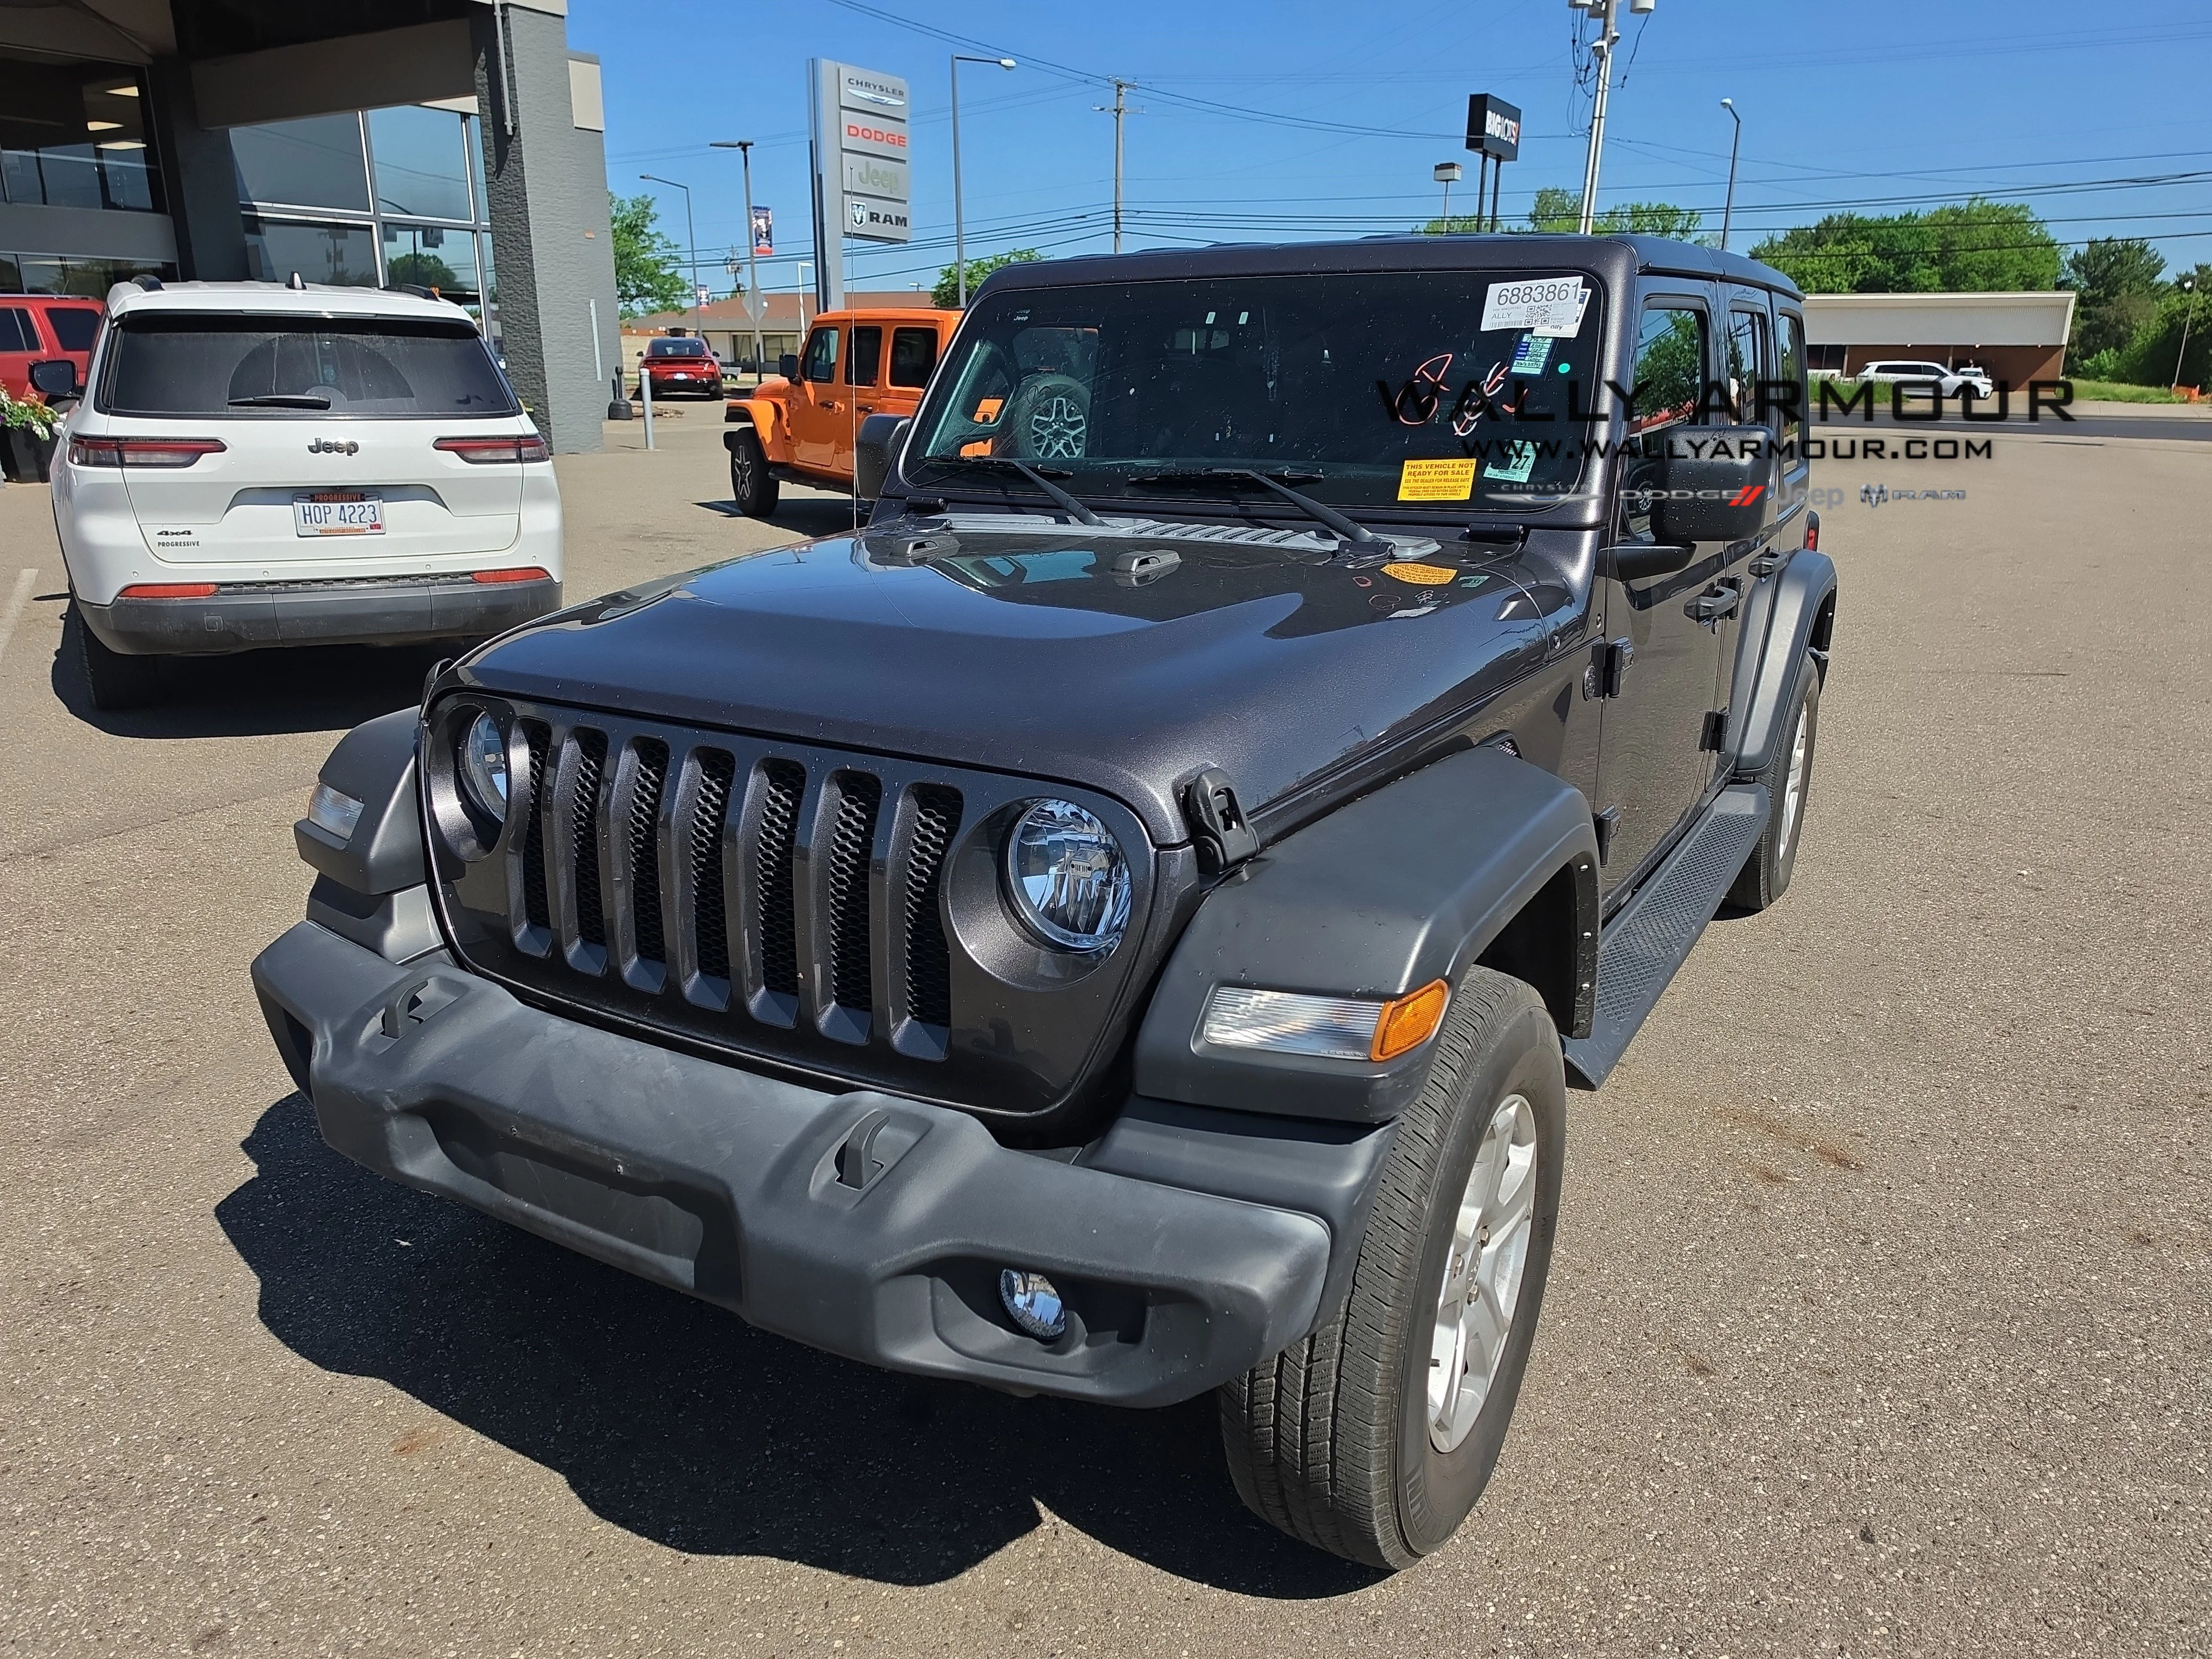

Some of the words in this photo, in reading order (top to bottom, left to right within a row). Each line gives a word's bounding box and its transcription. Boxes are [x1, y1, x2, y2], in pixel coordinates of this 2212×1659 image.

[848, 78, 904, 97] CHRYSLER
[847, 125, 906, 147] DODGE
[859, 162, 899, 194] Jeep
[869, 210, 908, 228] RAM
[1497, 282, 1579, 305] 6883861
[307, 438, 359, 456] Jeep
[314, 493, 362, 501] PROGRESSIVE
[302, 505, 332, 524] HOP
[338, 504, 377, 524] 4223
